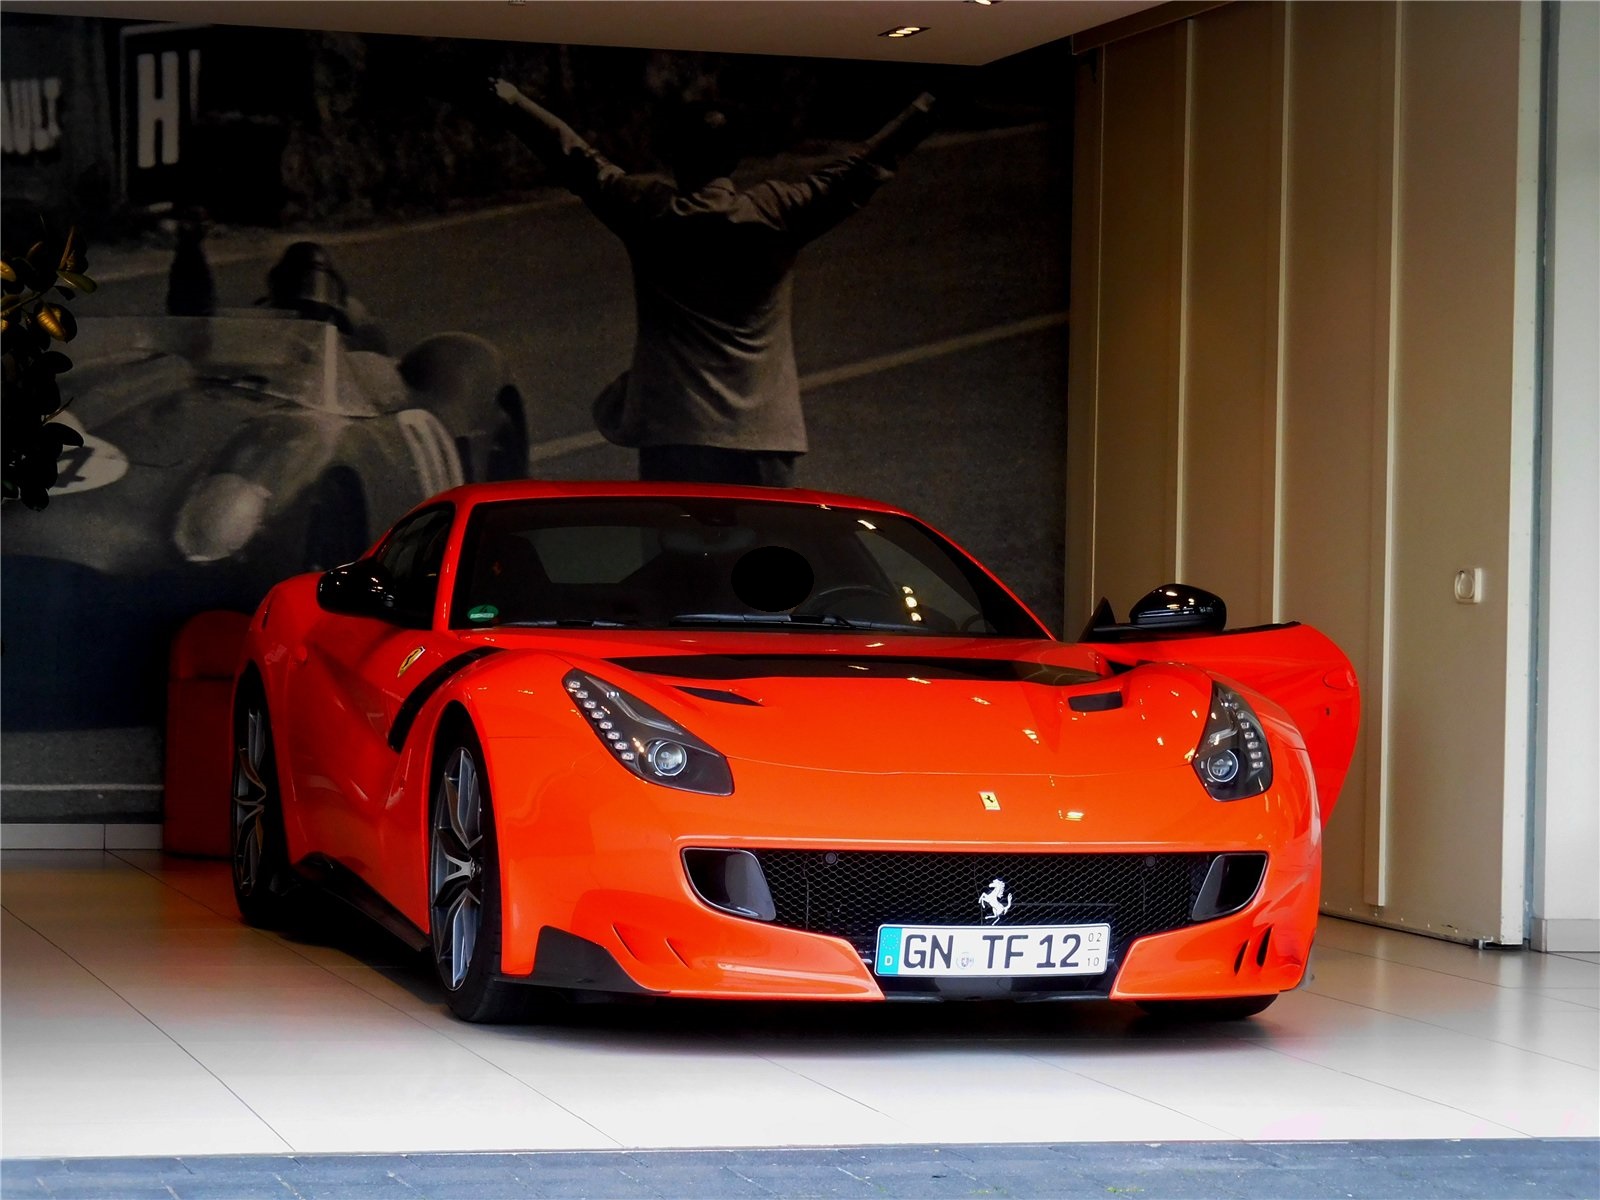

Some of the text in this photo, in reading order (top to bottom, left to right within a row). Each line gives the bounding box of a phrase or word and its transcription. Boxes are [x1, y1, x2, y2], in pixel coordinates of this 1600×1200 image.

[884, 933, 1081, 969] D GN TF 12
